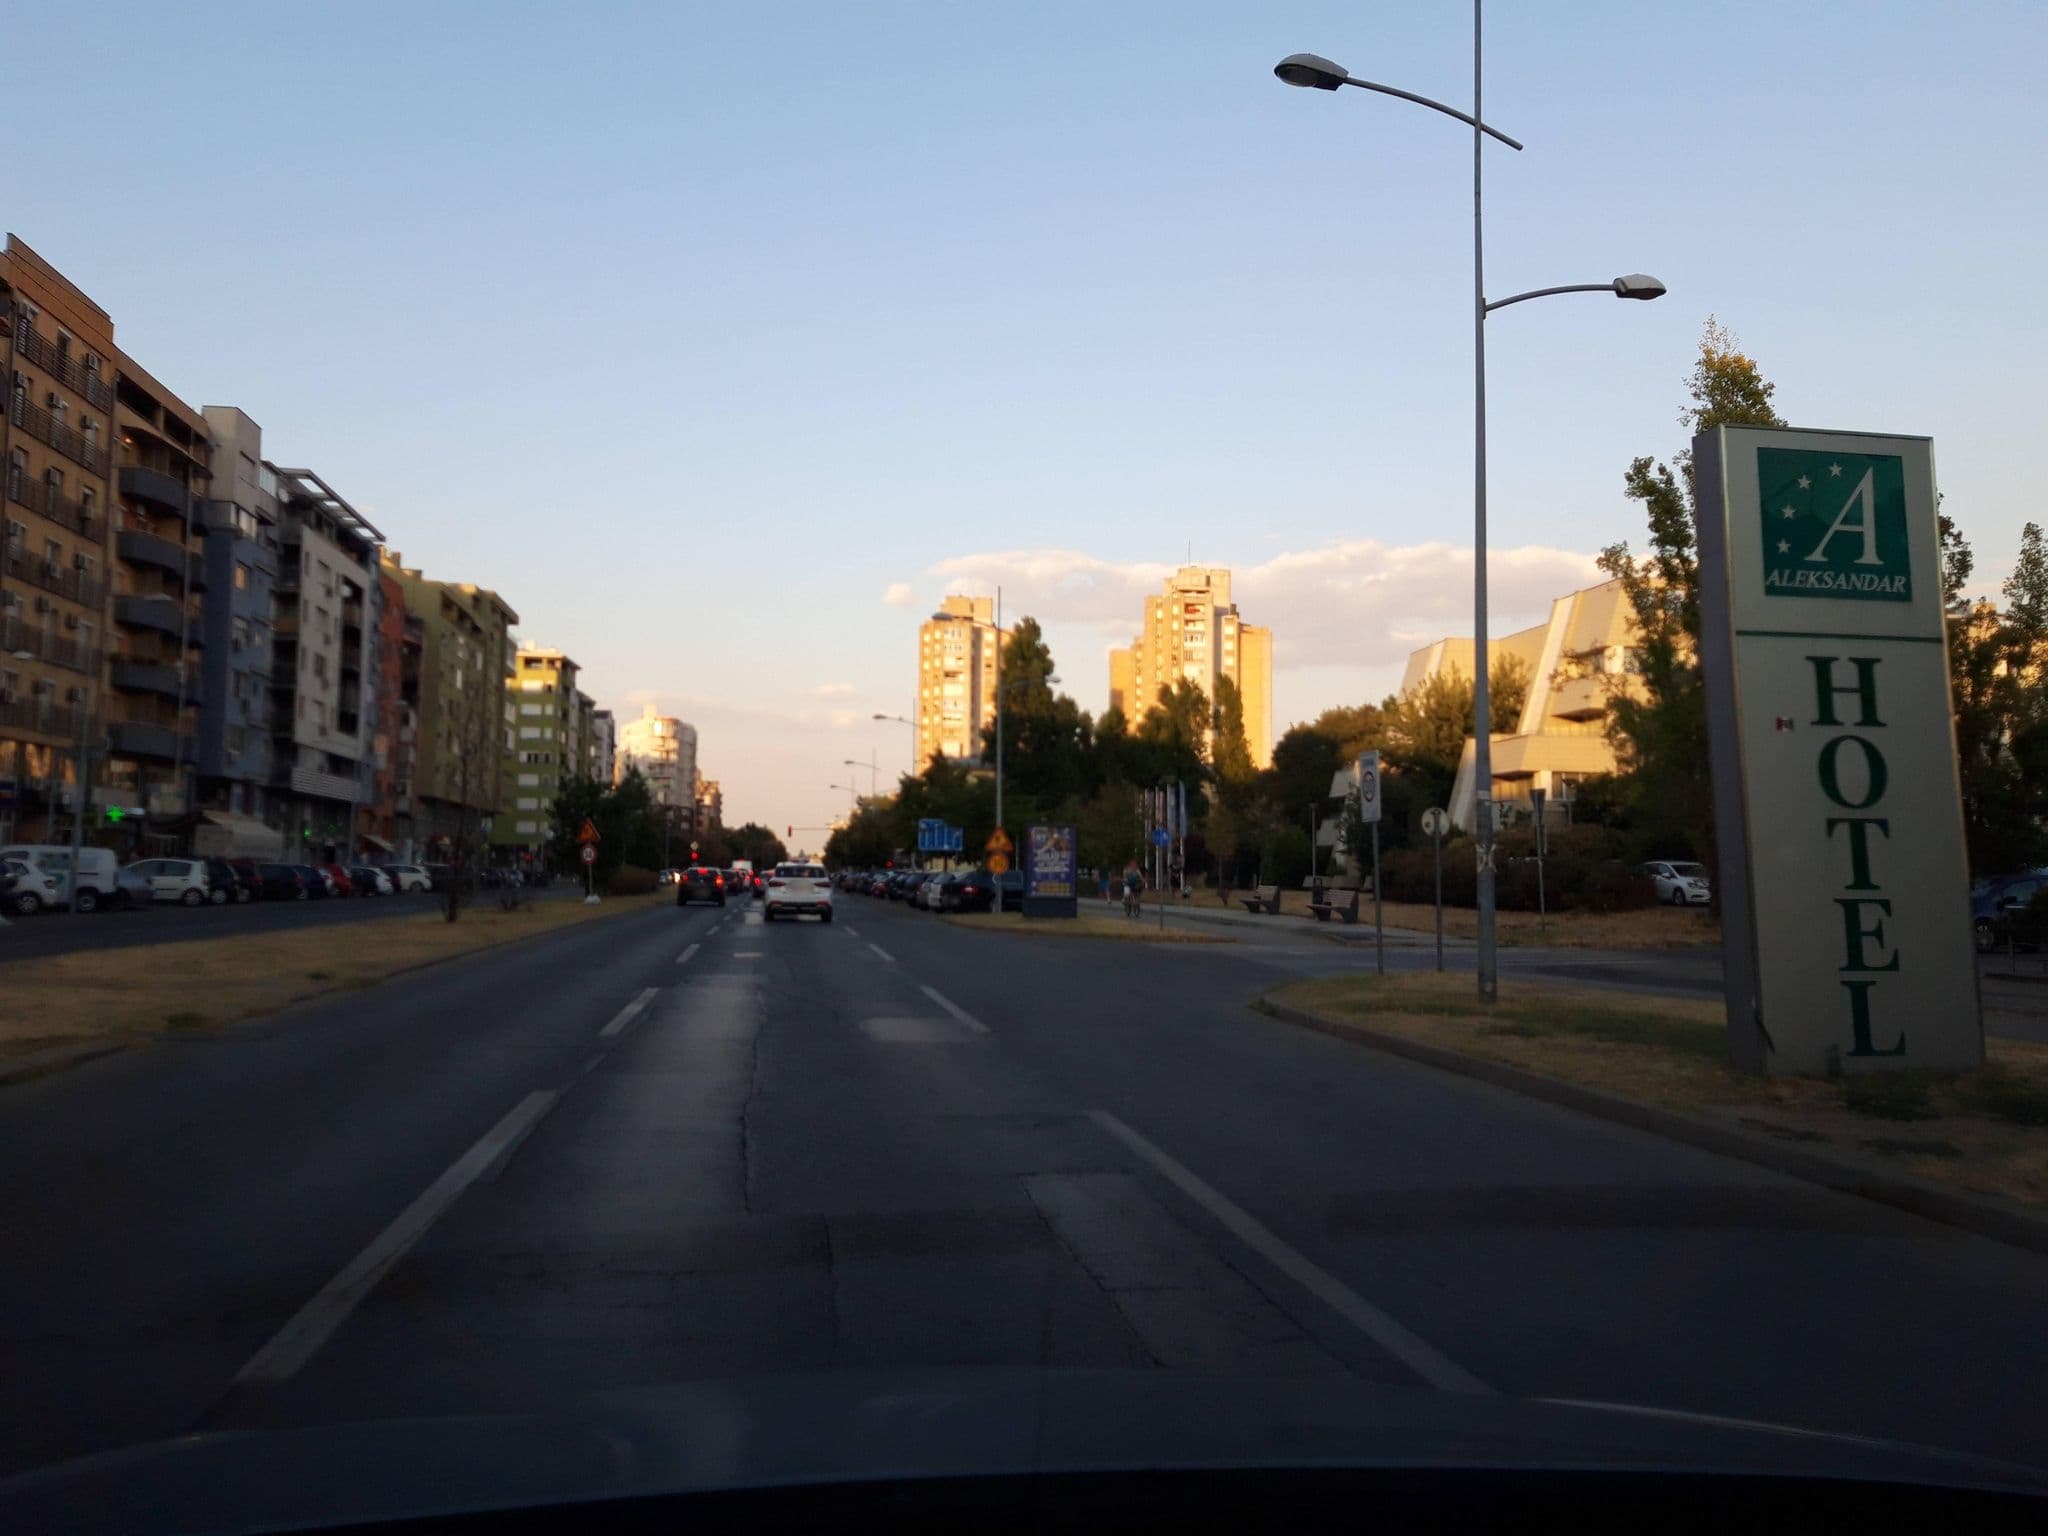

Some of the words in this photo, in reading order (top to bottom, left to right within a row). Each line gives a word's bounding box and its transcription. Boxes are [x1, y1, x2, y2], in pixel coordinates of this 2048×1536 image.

[1803, 466, 1885, 565] A
[1765, 568, 1907, 594] ALEKSANDAR
[1804, 655, 1906, 1057] HOTEL
